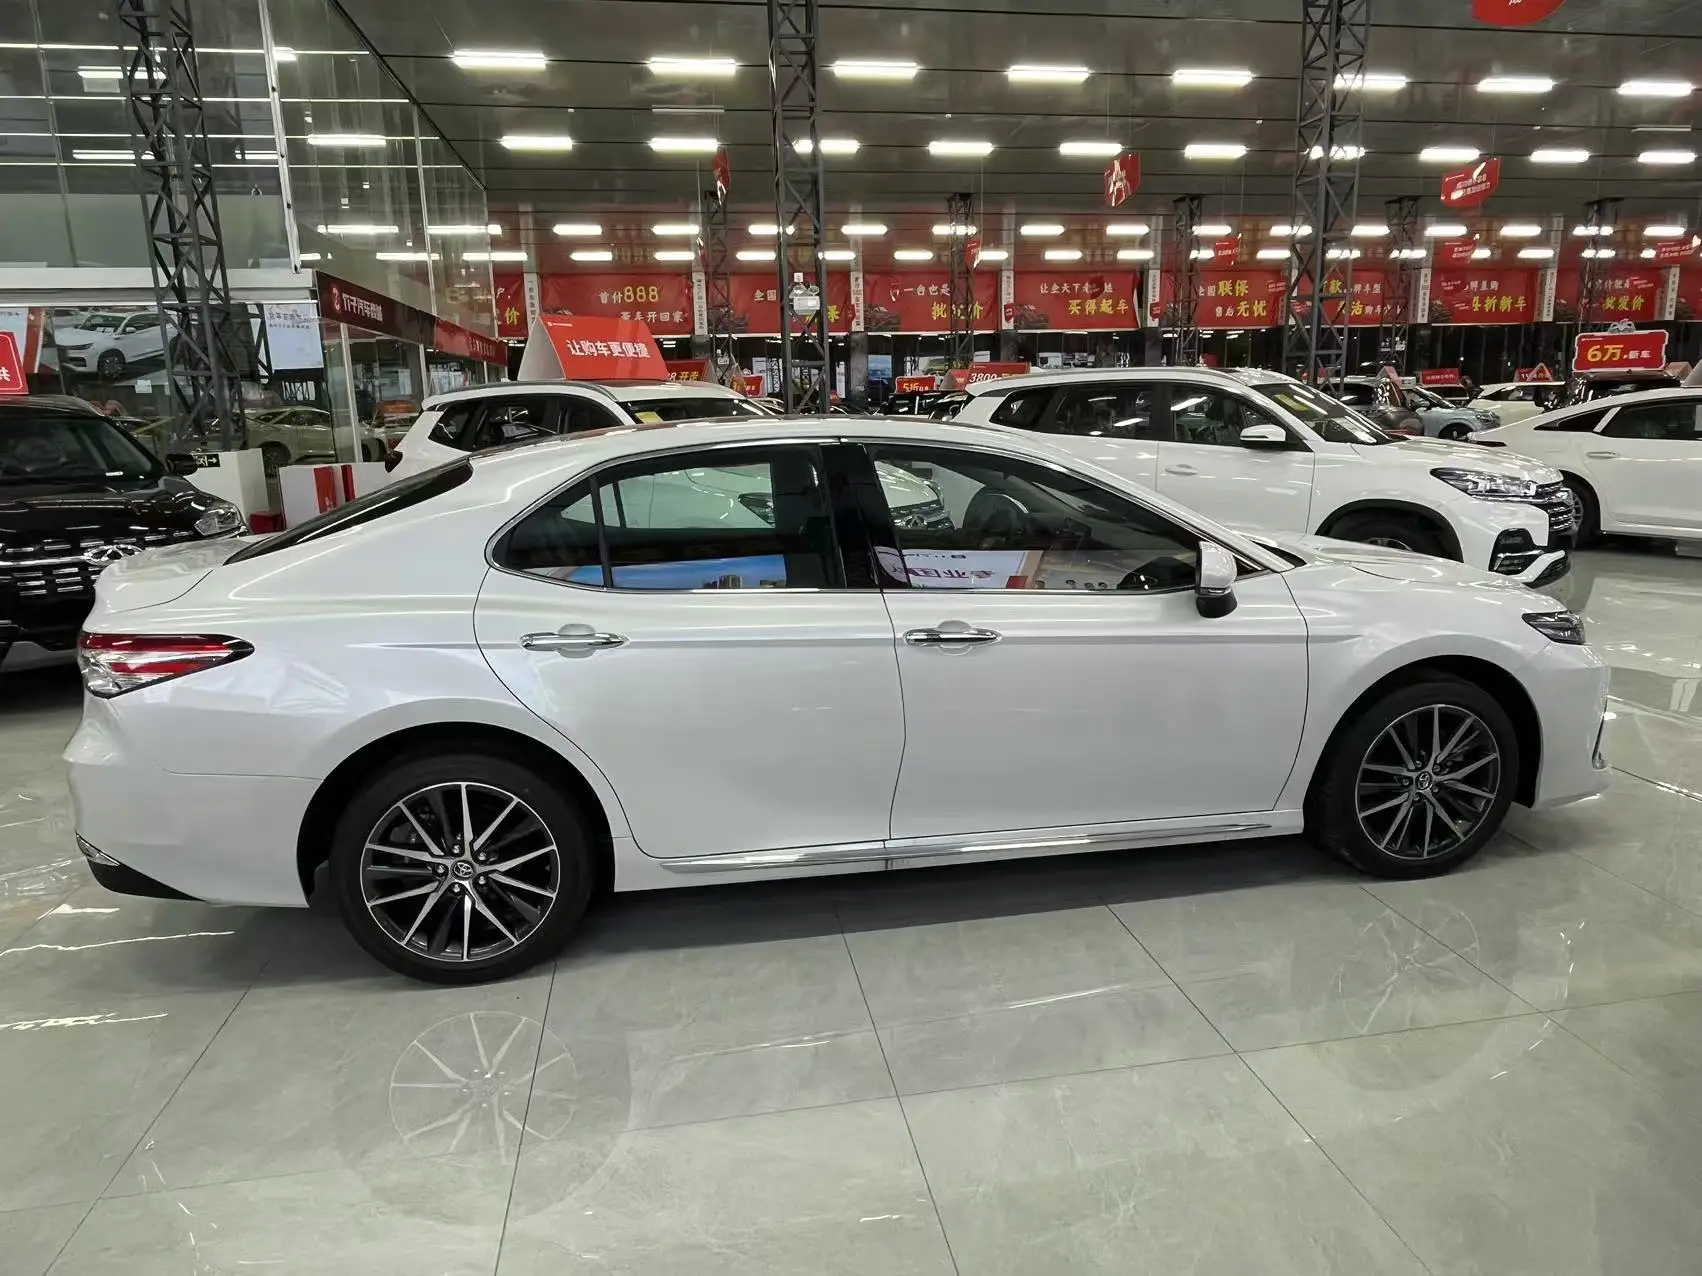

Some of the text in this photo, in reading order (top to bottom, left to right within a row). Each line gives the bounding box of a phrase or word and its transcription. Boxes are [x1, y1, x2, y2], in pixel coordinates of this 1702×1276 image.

[599, 286, 660, 304] 首付888
[1040, 282, 1113, 294] 让全天下老姓
[1068, 299, 1129, 315] 买得起车
[1215, 300, 1268, 318] 售后无忧
[566, 339, 650, 359] 让购车更便捷
